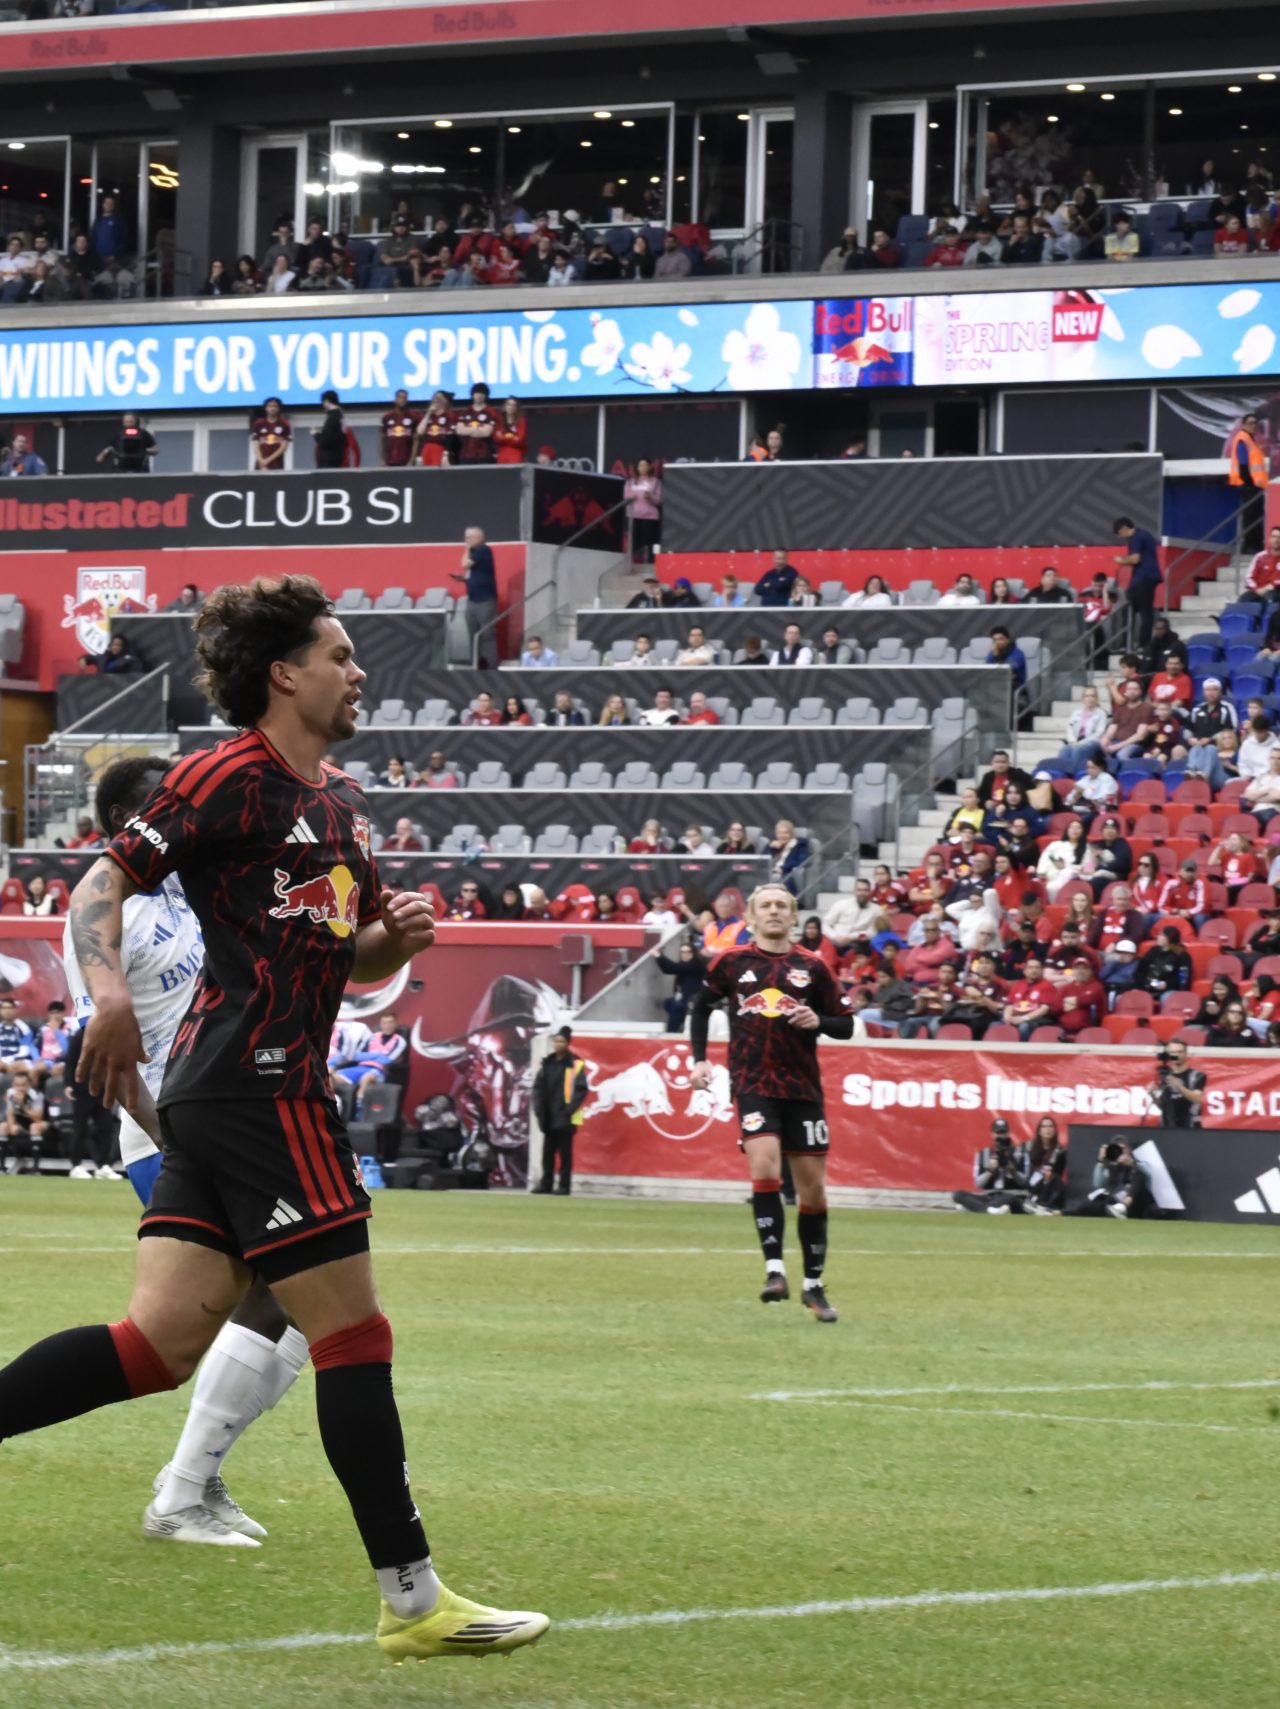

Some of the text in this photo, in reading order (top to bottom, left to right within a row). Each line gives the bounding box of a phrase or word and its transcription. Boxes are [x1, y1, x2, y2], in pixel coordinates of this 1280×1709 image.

[815, 301, 913, 335] Red Bull
[1054, 310, 1099, 336] NEW
[172, 335, 255, 395] FOR
[270, 330, 390, 391] YOUR
[403, 322, 582, 387] SPRING.
[202, 488, 352, 528] CLUB
[366, 487, 414, 525] SI
[842, 1073, 982, 1110] Sports
[802, 1119, 830, 1146] 10
